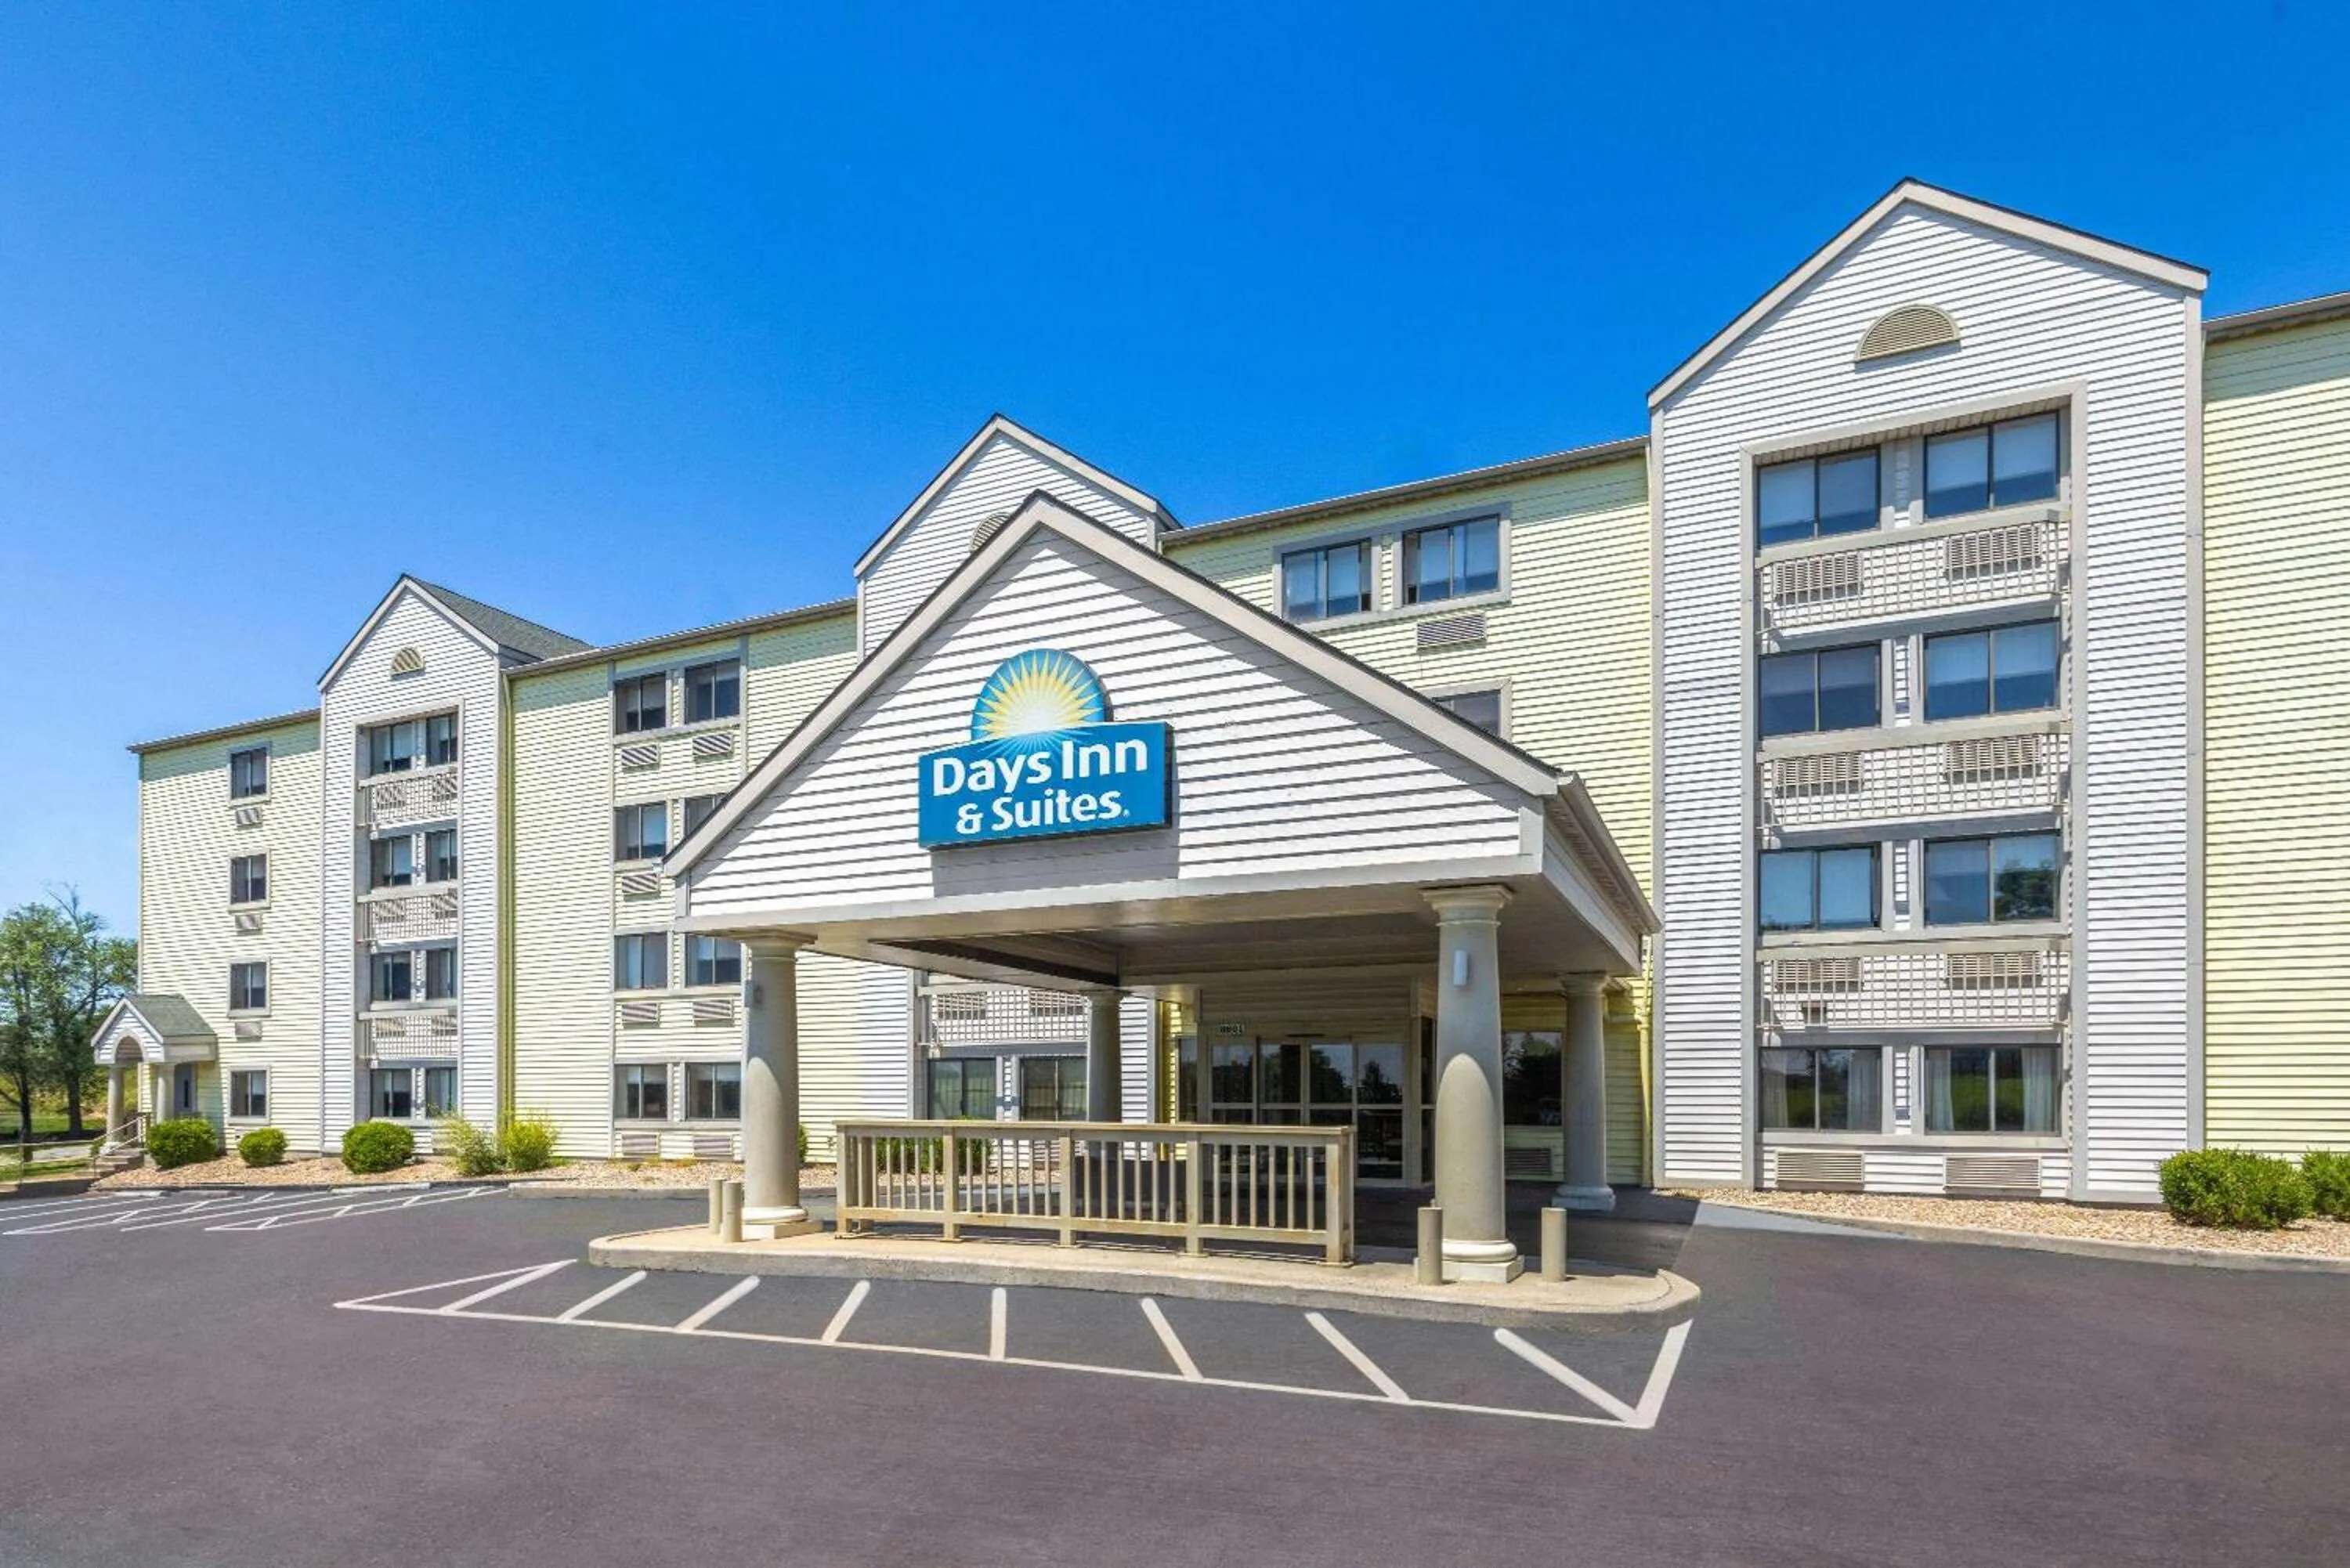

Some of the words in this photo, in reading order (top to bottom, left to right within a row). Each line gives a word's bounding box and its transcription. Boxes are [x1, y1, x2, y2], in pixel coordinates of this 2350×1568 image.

[933, 751, 1052, 797] Days
[1061, 739, 1147, 779] Inn
[956, 803, 983, 834] &
[991, 789, 1123, 831] Suites
